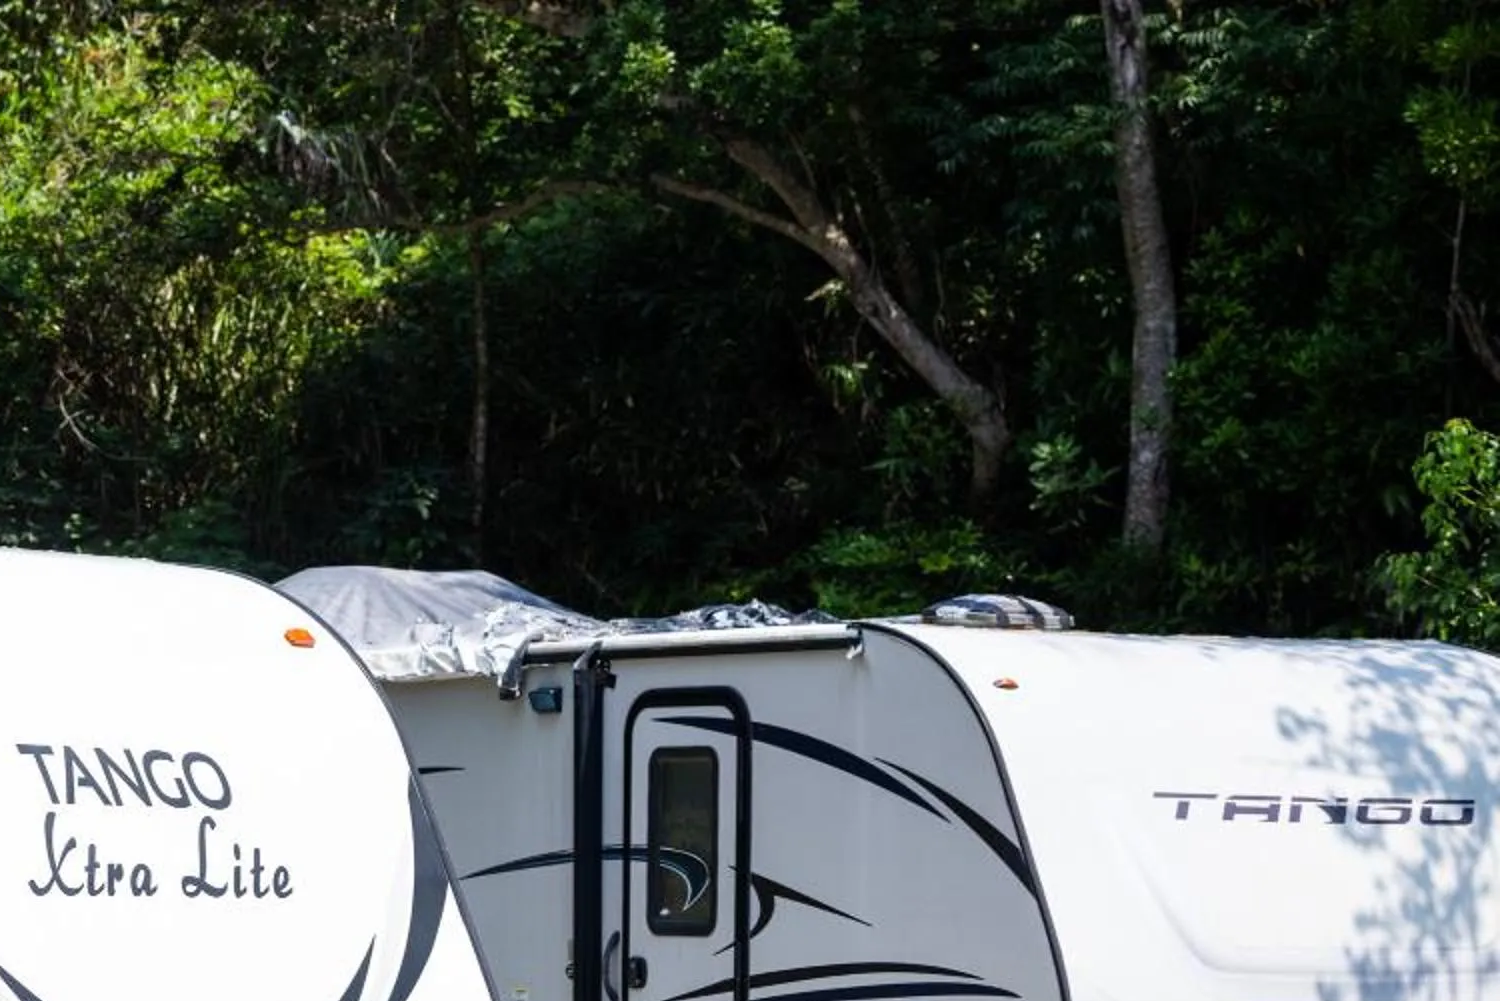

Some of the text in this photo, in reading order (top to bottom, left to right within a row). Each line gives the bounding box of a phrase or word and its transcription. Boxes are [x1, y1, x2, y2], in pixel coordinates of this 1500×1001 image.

[15, 743, 233, 810] TANGO
[1153, 791, 1475, 826] TANGO
[28, 811, 294, 899] Xtra Lite
